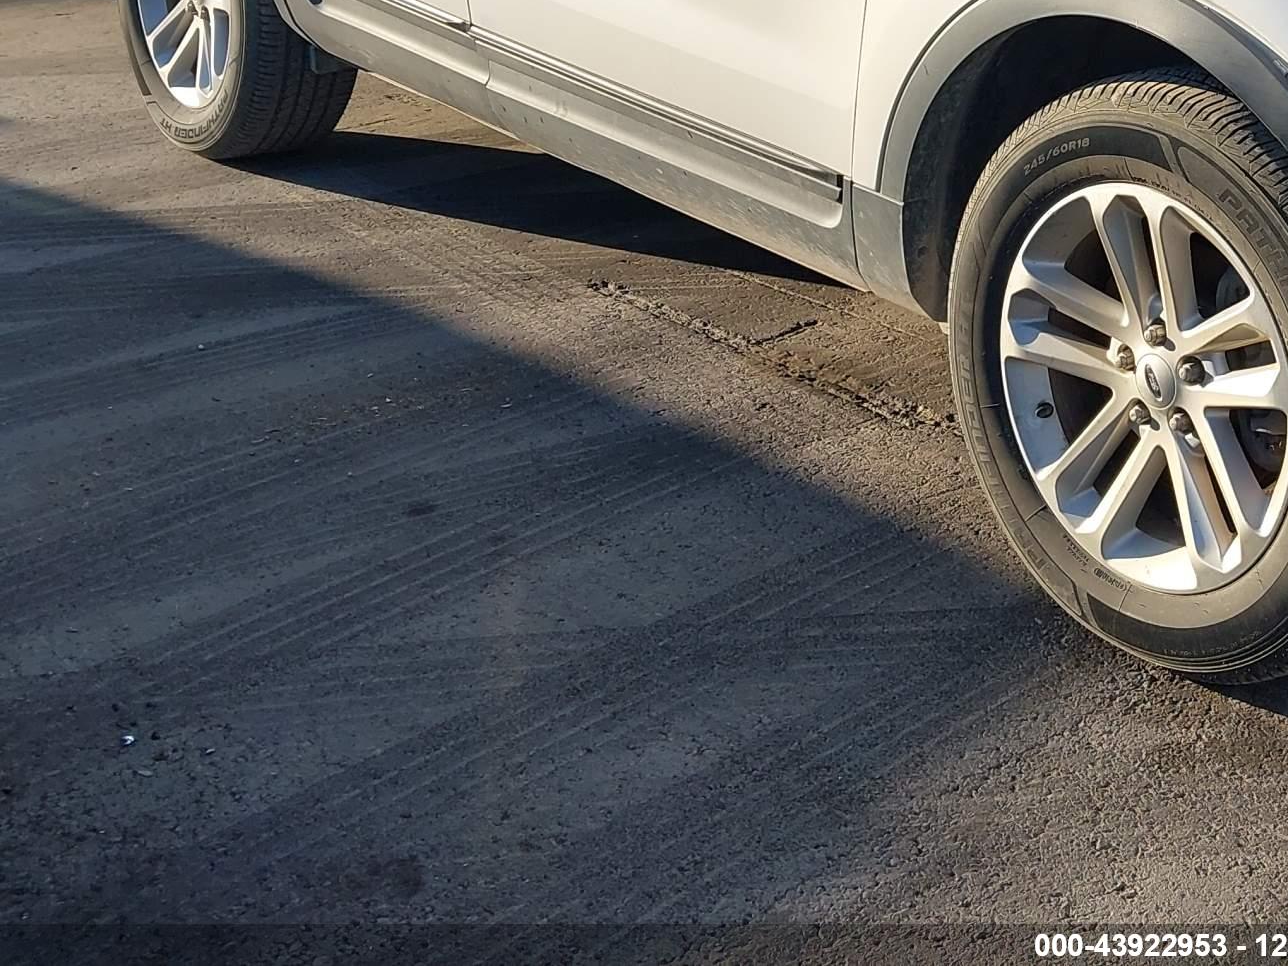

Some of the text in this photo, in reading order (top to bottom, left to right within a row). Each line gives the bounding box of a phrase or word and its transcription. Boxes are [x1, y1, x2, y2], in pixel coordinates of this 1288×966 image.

[159, 89, 229, 138] PATHFINDER HT
[1023, 137, 1090, 175] 245/60R18
